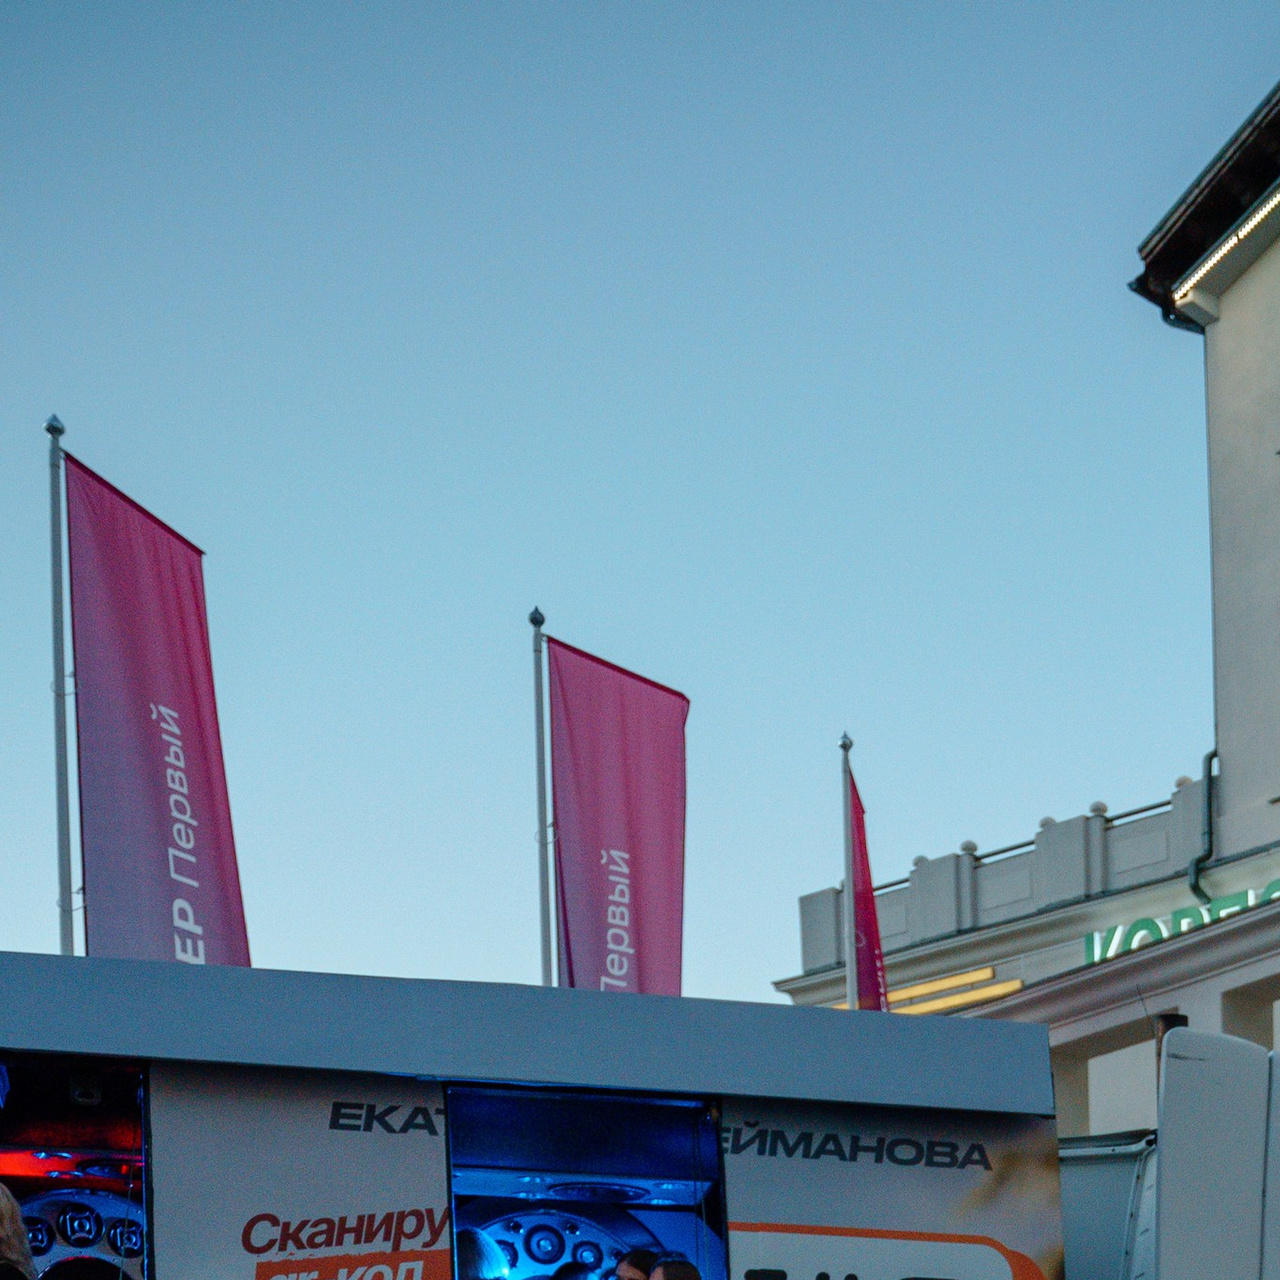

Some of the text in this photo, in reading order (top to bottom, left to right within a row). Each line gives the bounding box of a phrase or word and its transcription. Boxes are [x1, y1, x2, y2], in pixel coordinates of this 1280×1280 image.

[149, 702, 201, 888] Первый
[329, 1101, 446, 1137] ЕКА
[241, 1206, 449, 1255] Сканиру
